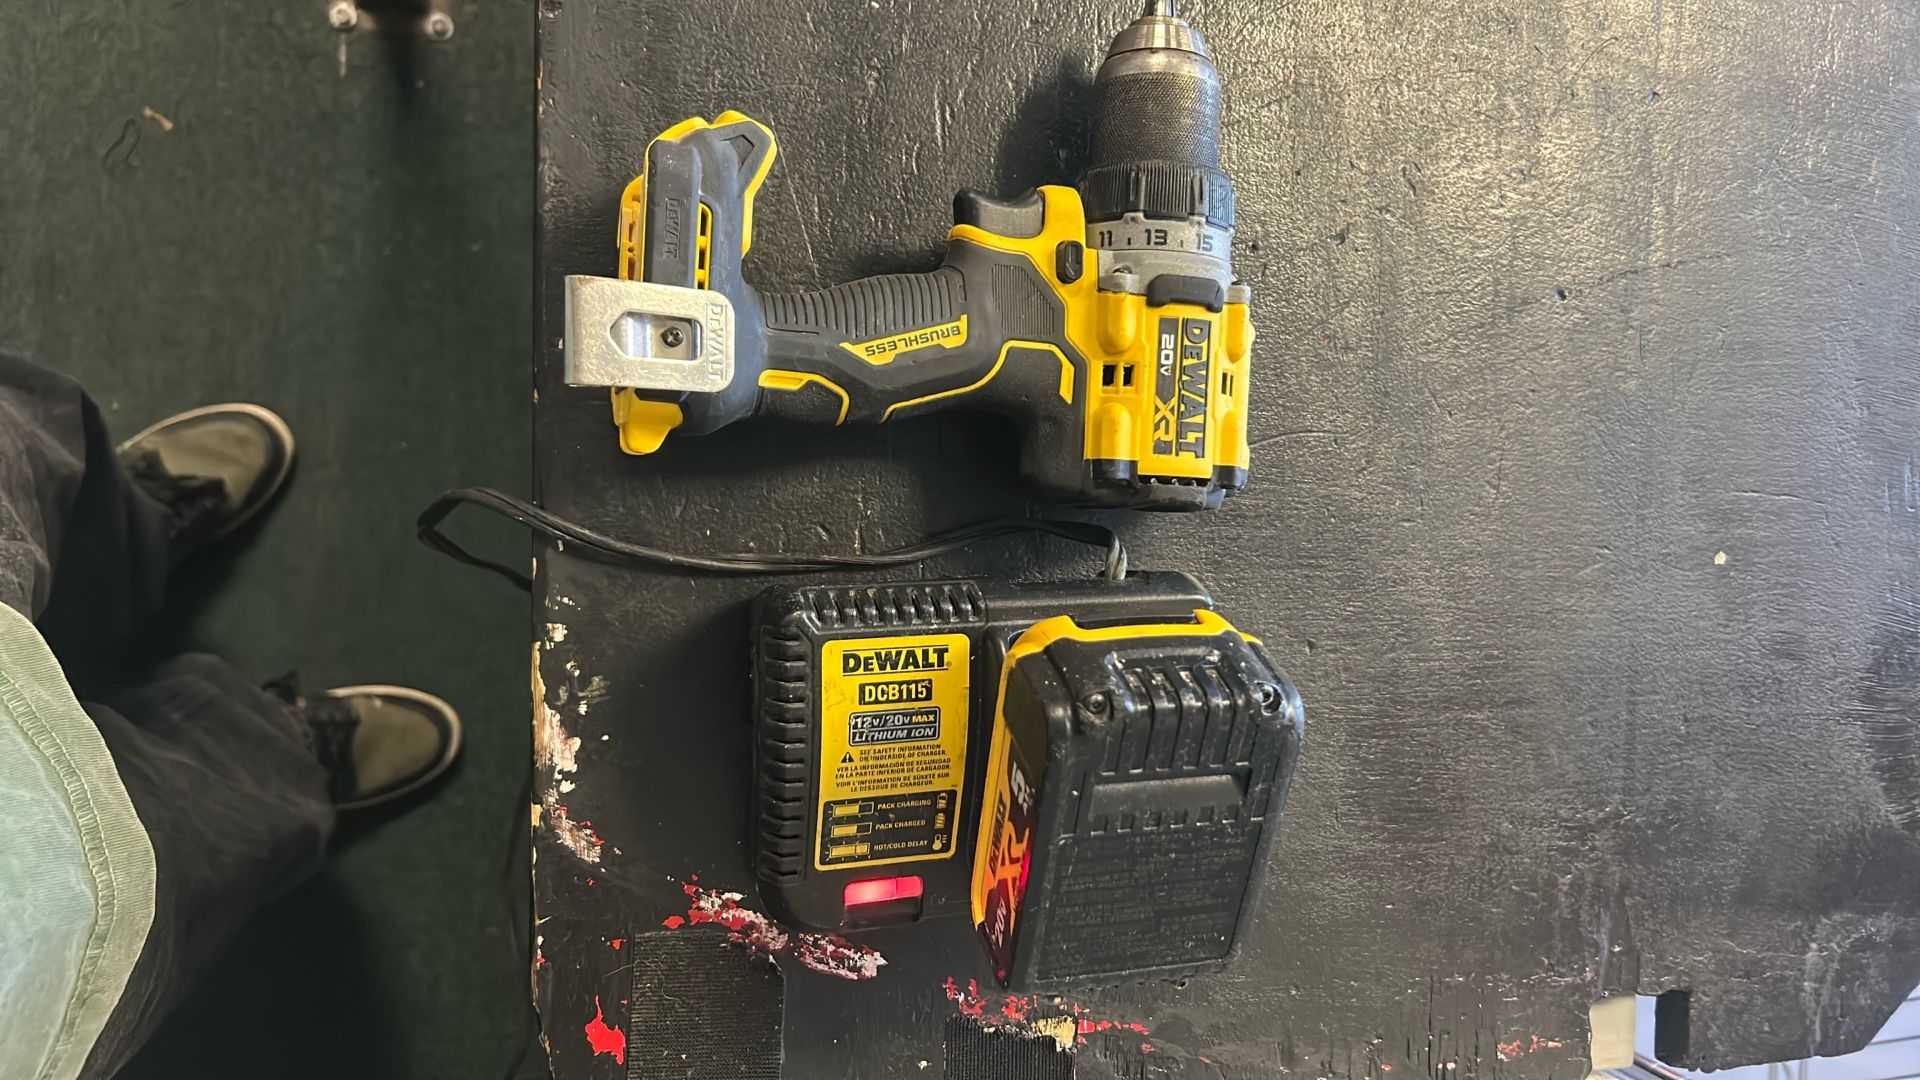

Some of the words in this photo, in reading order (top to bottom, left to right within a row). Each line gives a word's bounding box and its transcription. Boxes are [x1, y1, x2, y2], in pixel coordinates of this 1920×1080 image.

[1099, 230, 1113, 247] 11
[1145, 229, 1168, 246] 13
[1196, 233, 1213, 252] 15
[865, 325, 961, 356] BRUSHLESS
[1160, 333, 1175, 376] 20V
[1153, 395, 1177, 442] XR
[864, 683, 927, 702] DCB115
[912, 714, 935, 723] MAX
[854, 729, 907, 742] LITHIUM
[911, 727, 934, 737] ION
[873, 747, 896, 755] SAFETY
[898, 744, 941, 752] INFORMATION
[870, 753, 905, 761] UNDERSIDE
[916, 757, 951, 765] SEGURIDAD
[876, 767, 905, 775] INFERIOR
[860, 783, 889, 791] DESSOUS
[1011, 761, 1027, 804] 5
[877, 802, 896, 810] PACK
[896, 799, 932, 808] CHARGING
[875, 822, 893, 830] PACK
[894, 819, 926, 828] CHARGED
[874, 843, 906, 851] HOT/COLD
[907, 840, 929, 848] DELAY
